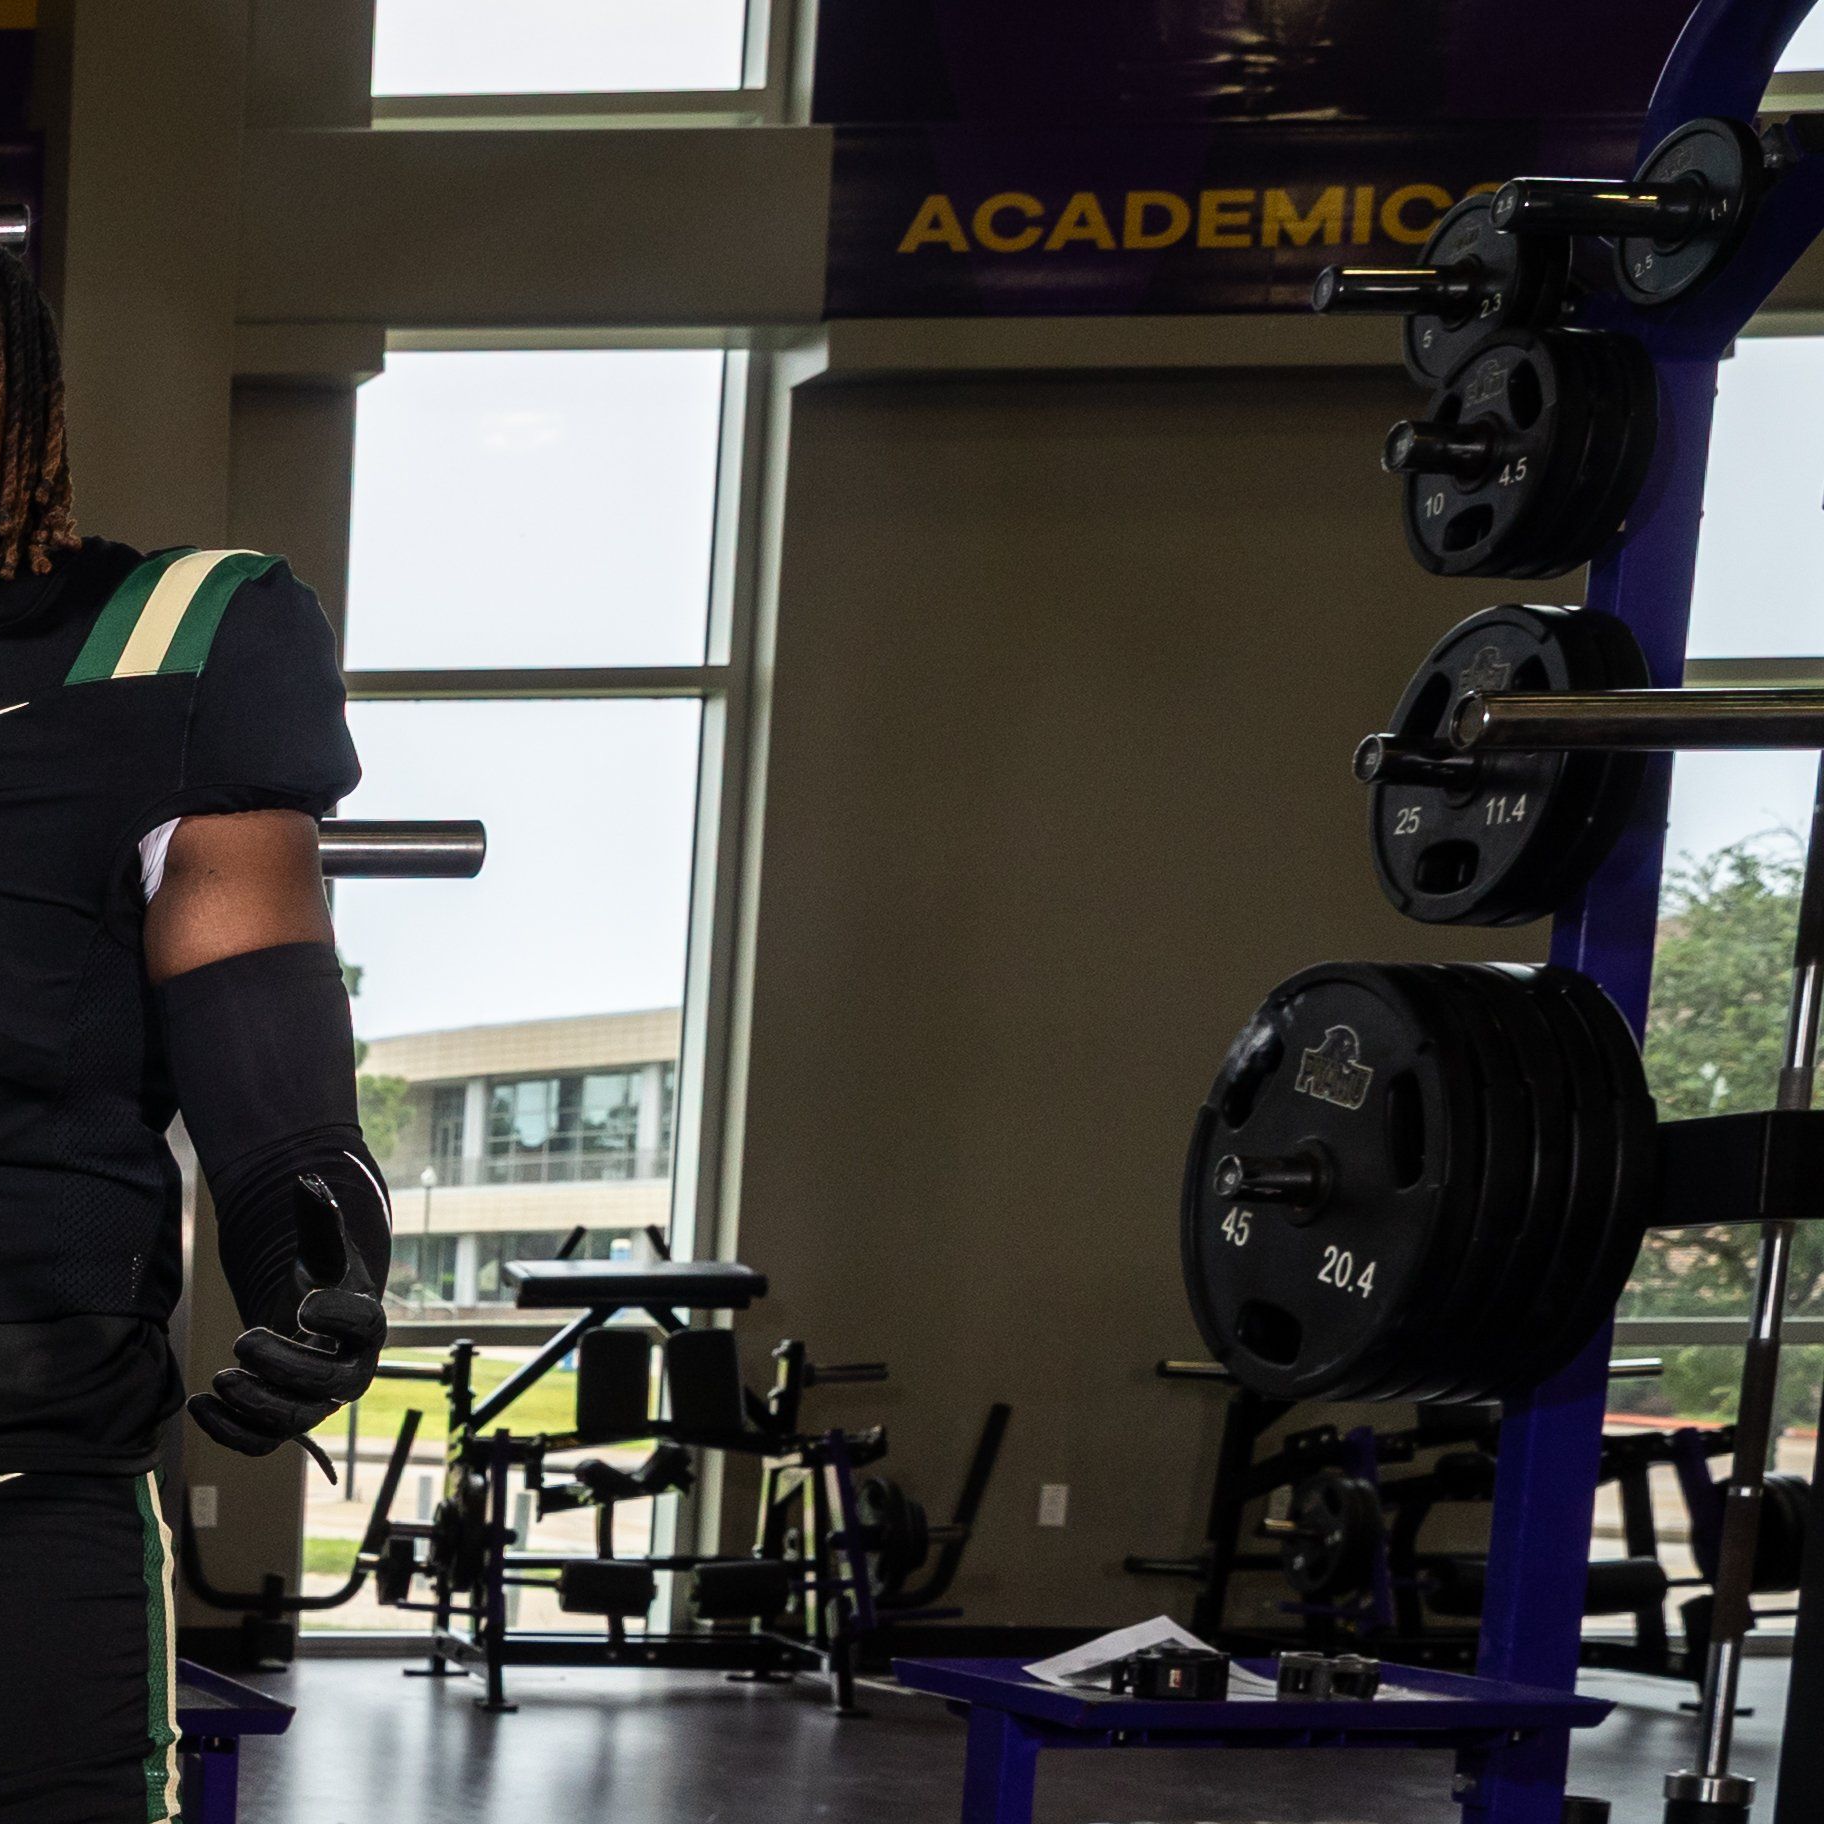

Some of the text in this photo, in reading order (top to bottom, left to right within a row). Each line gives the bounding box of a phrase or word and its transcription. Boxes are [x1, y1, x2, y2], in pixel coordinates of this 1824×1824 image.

[896, 182, 1508, 254] ACADEMIC
[1497, 456, 1529, 487] 4.5
[1423, 492, 1445, 518] 10
[1393, 806, 1422, 836] 25
[1484, 793, 1528, 826] 11.4
[1220, 1206, 1252, 1247] 45
[1317, 1244, 1377, 1299] 20.4
